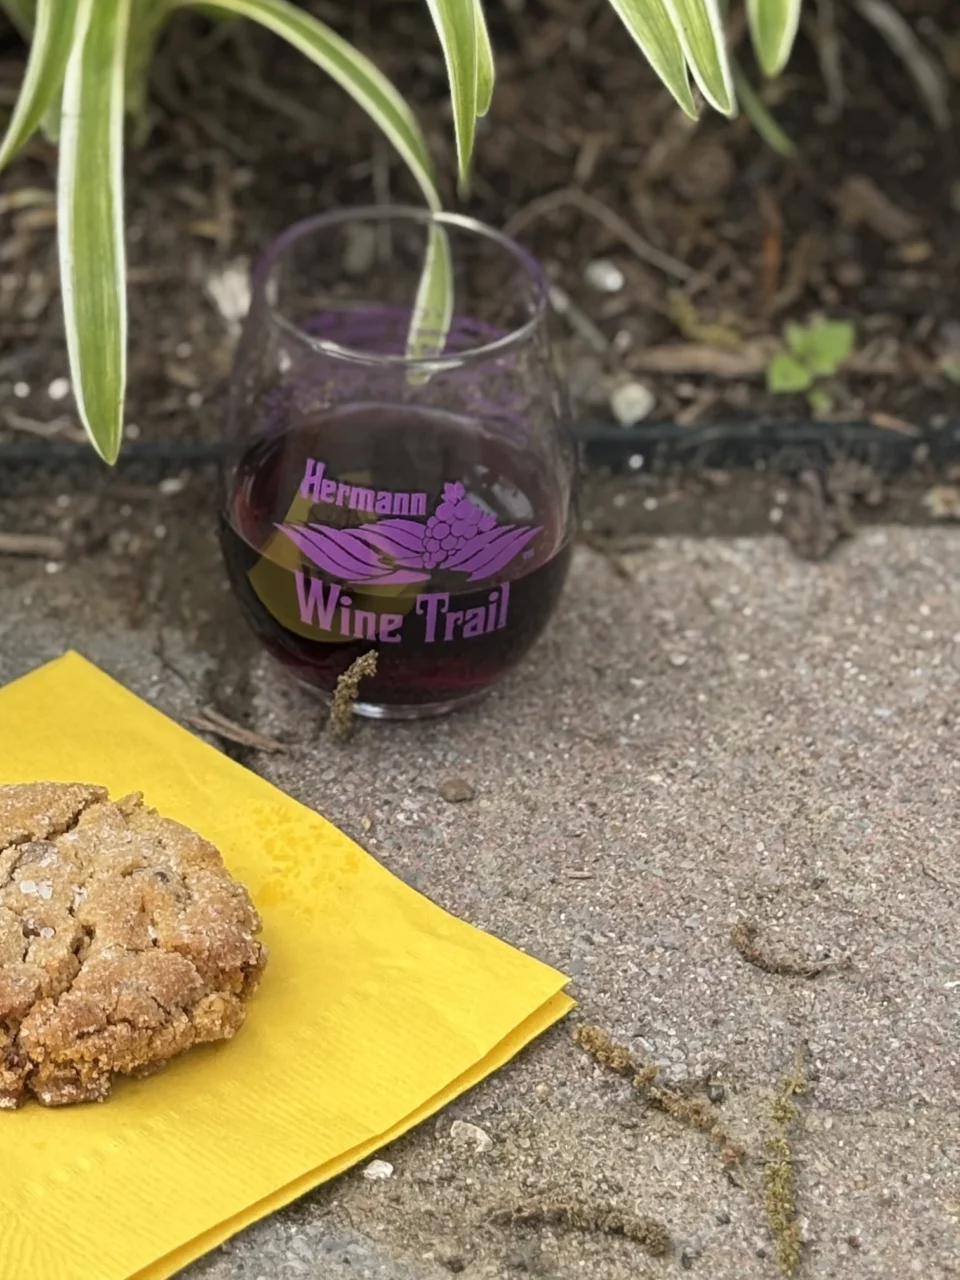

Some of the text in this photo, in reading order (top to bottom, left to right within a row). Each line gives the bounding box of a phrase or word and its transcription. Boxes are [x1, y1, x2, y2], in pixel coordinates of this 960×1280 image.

[300, 457, 427, 516] Hermann
[294, 570, 510, 643] Wine Trail
